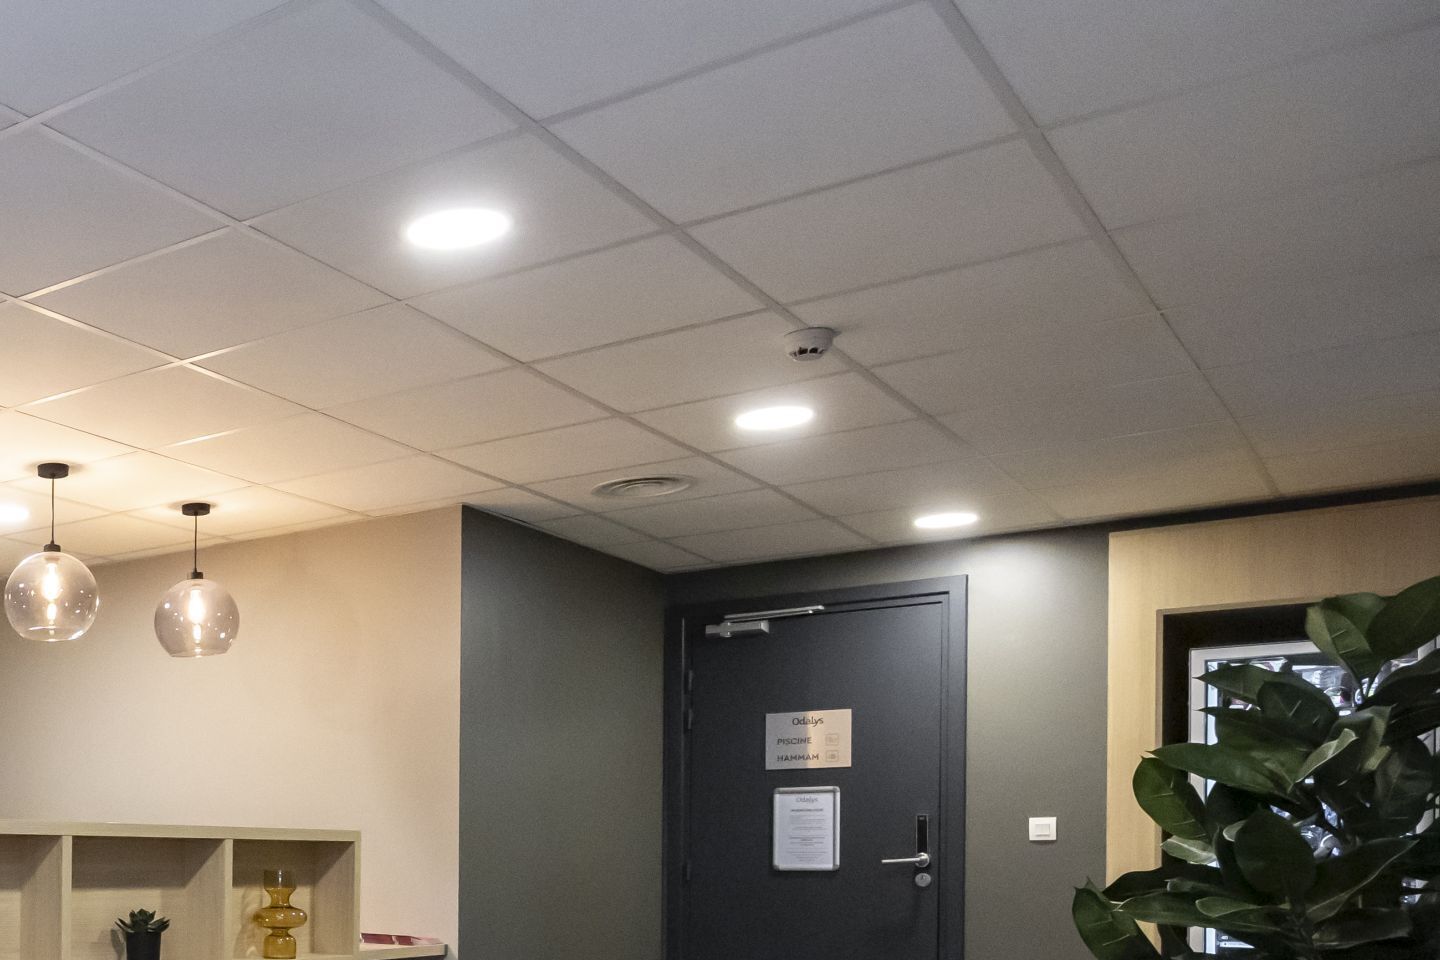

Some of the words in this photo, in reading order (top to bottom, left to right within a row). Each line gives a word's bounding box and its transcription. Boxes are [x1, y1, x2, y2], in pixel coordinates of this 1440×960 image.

[791, 716, 824, 727] Odalys
[777, 736, 812, 745] PISCINE
[776, 753, 820, 762] HAMMAM
